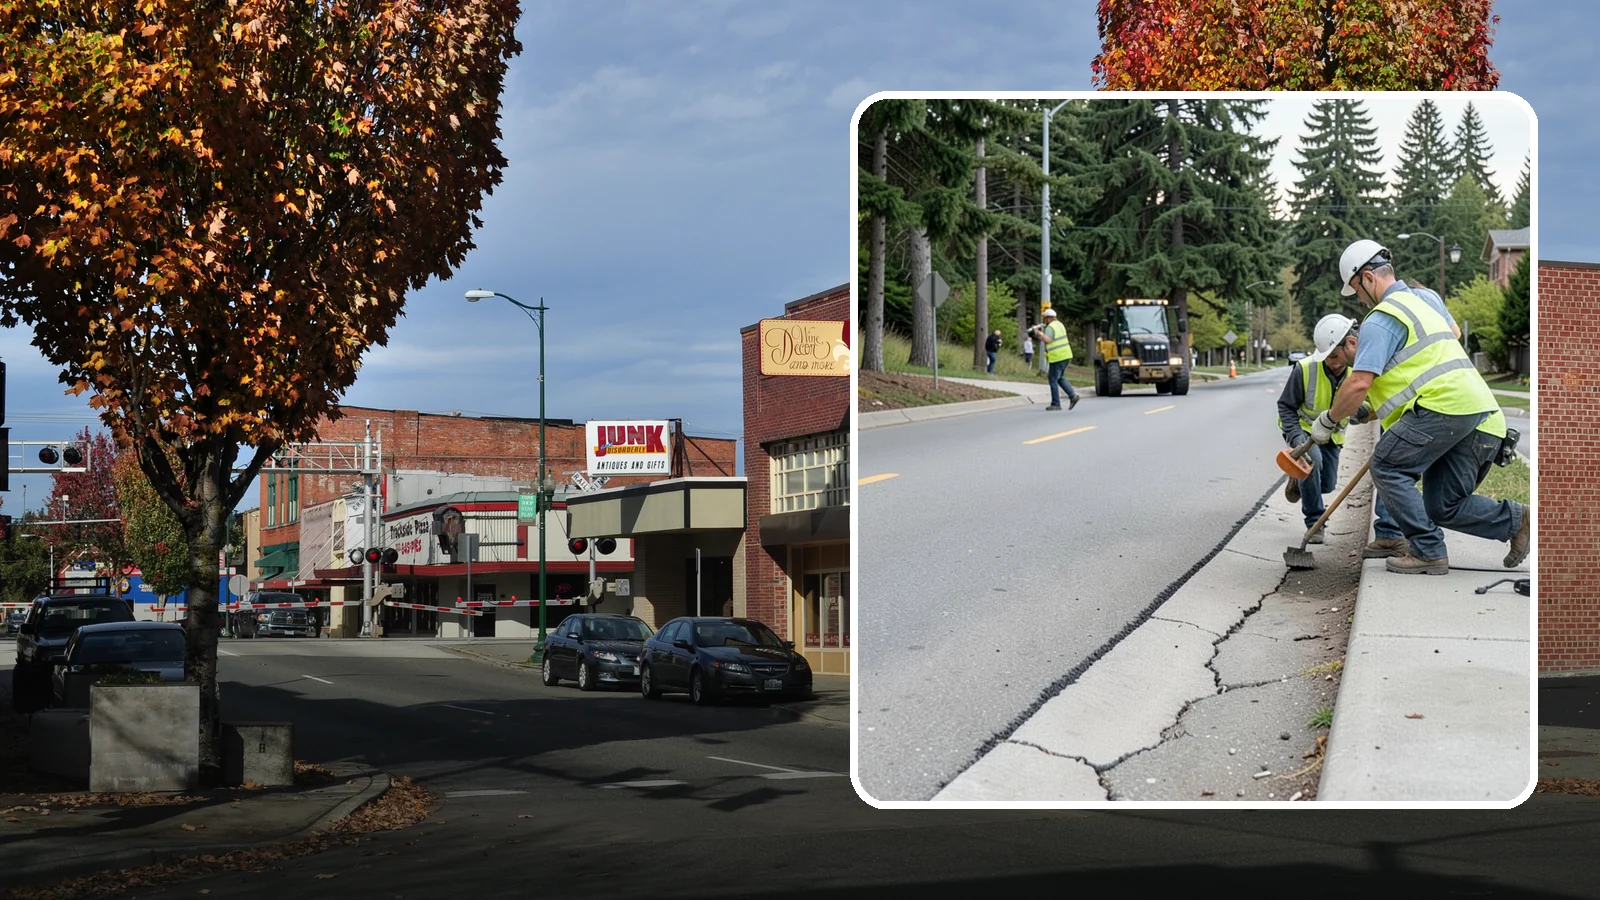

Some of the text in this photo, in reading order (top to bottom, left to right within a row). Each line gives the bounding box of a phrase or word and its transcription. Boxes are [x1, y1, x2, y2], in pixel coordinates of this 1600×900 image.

[596, 426, 664, 457] JUNK
[607, 446, 646, 454] DISORDERLY
[596, 460, 665, 470] ANTIQUES AND GIFTS
[390, 519, 429, 539] Trackside Pizza
